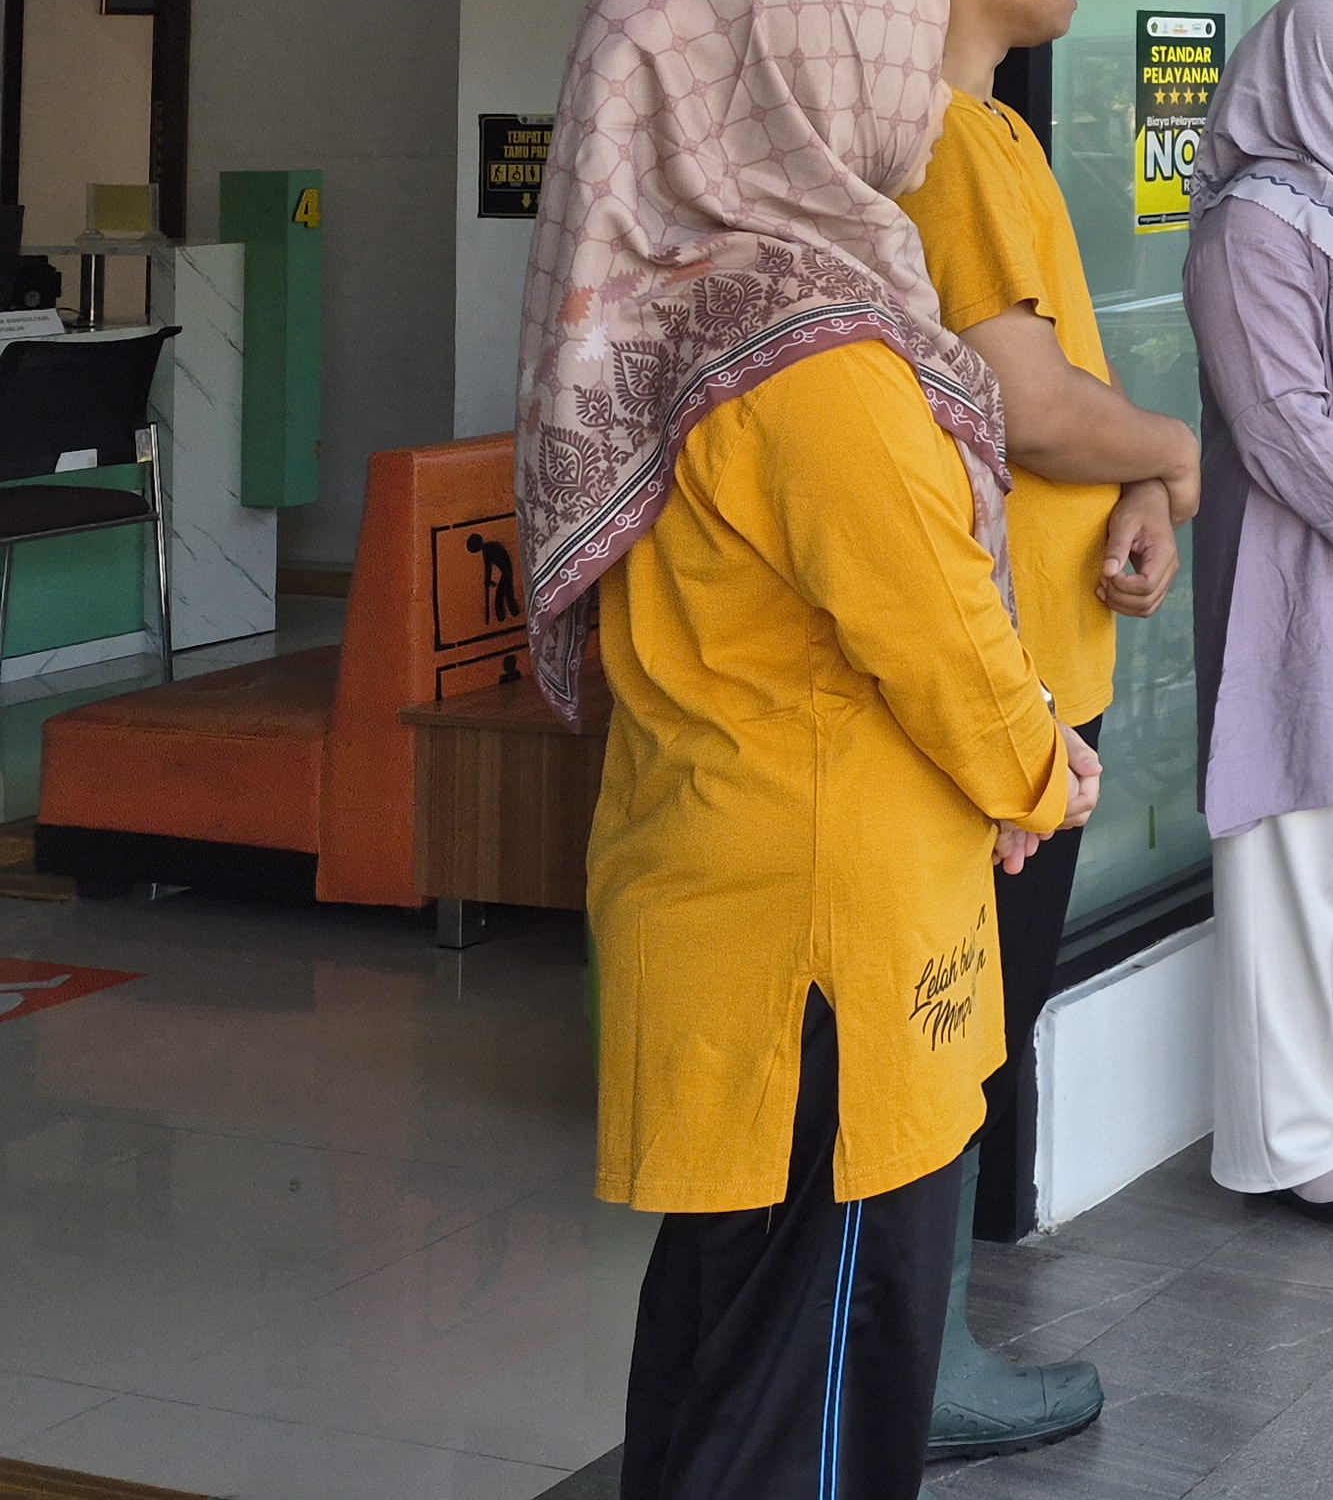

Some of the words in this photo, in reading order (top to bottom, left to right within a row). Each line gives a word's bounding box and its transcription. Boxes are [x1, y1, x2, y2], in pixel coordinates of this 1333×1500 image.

[1150, 45, 1212, 64] STANDAR
[1143, 66, 1219, 84] PELAYANAN
[1146, 115, 1170, 128] Biaya
[507, 130, 543, 144] TEMPAT
[503, 145, 530, 158] TAMU
[294, 188, 322, 228] 4
